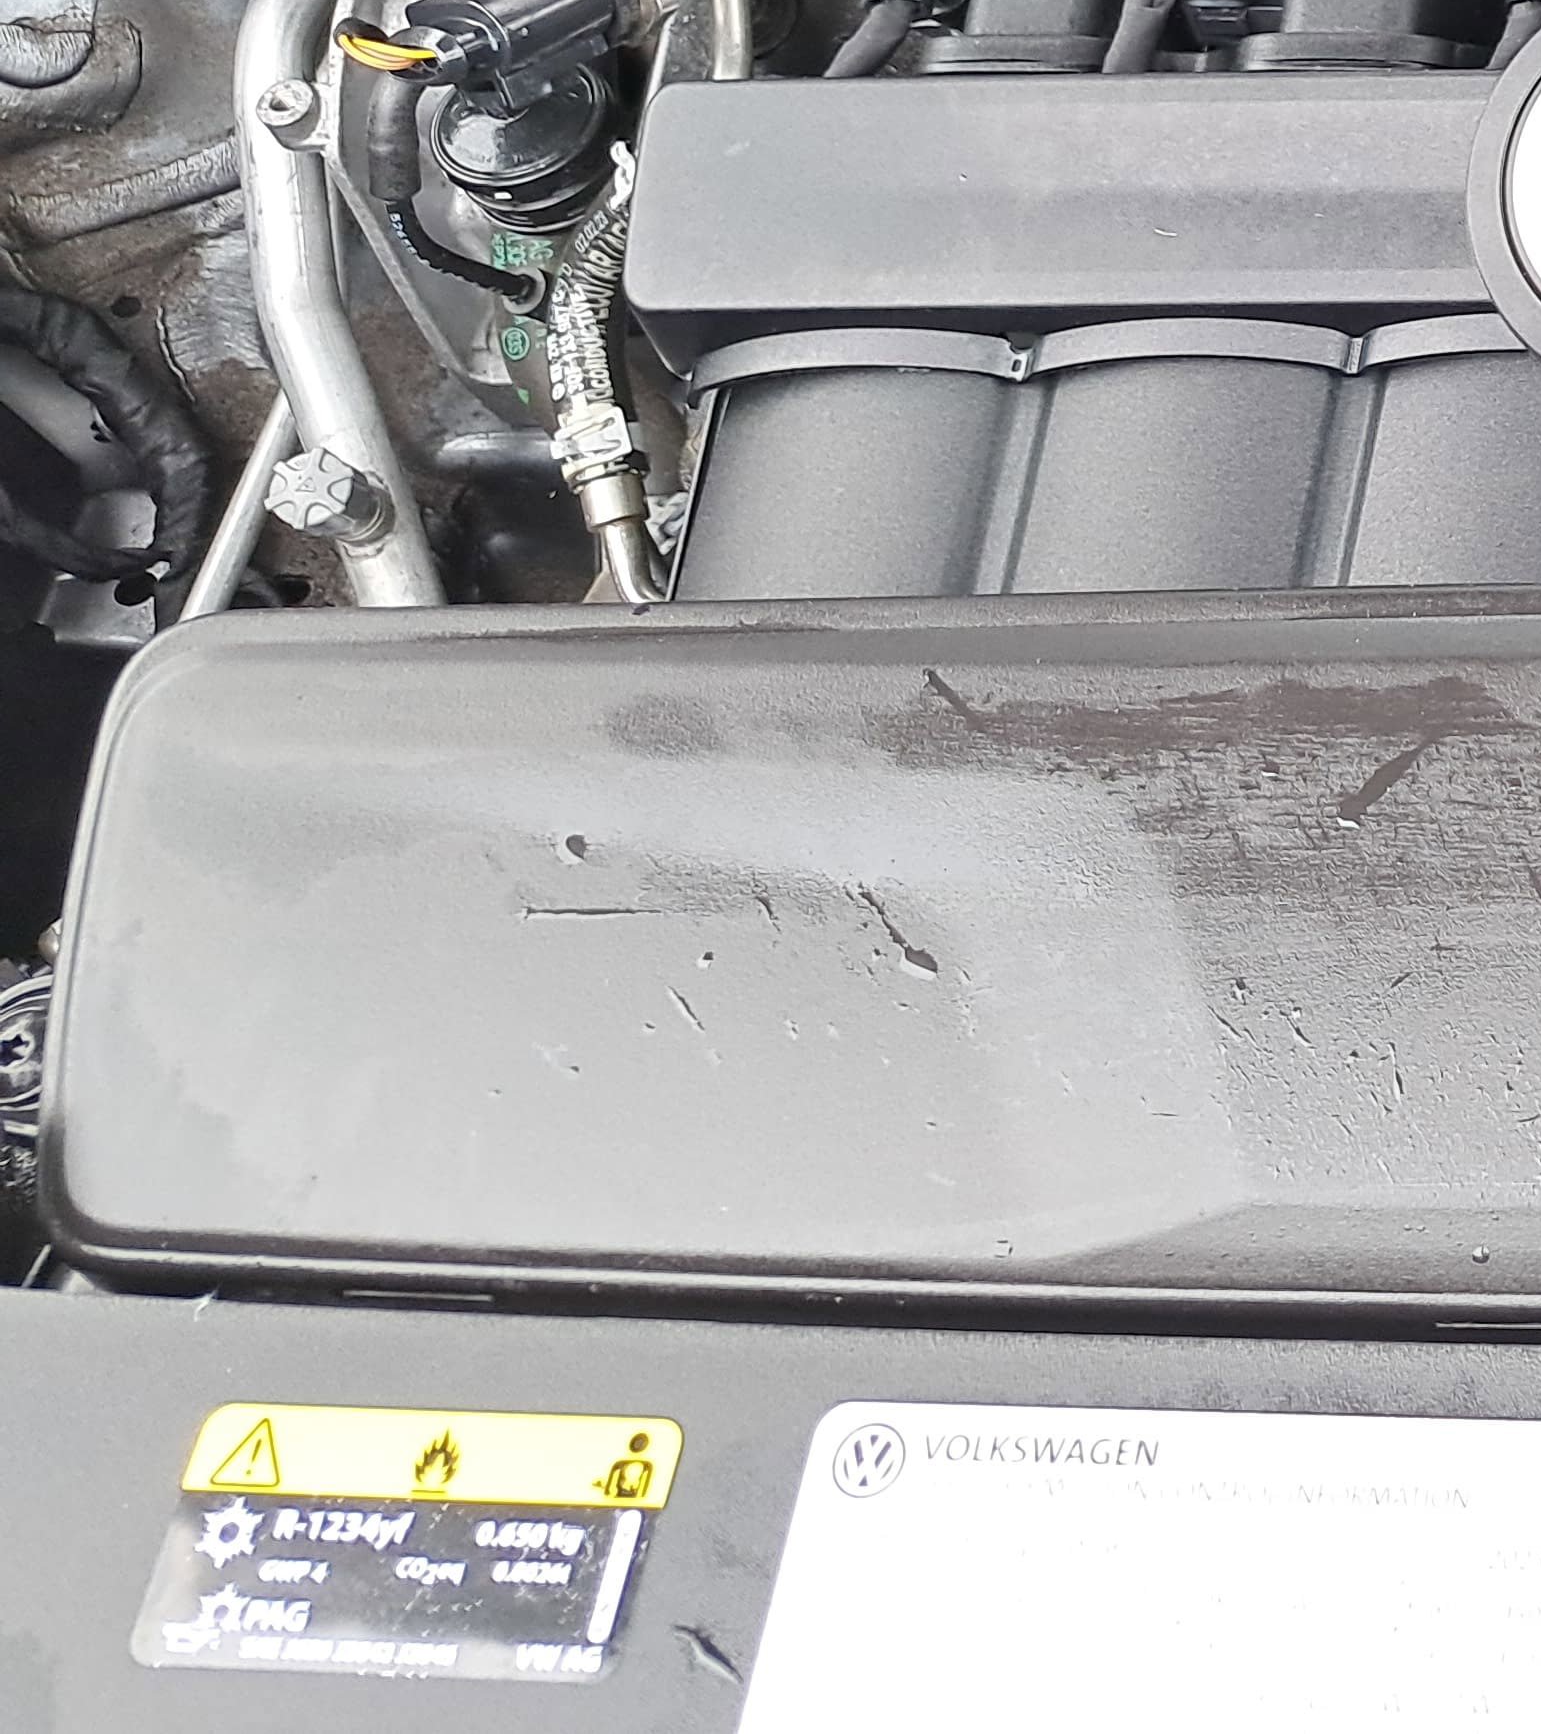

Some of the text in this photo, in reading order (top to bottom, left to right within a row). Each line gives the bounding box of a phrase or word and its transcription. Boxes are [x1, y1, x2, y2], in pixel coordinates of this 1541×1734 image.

[925, 1434, 1161, 1468] VOLKSWAGEN
[273, 1509, 414, 1550] R-1234yf
[244, 1598, 312, 1633] PAG
[515, 1643, 604, 1674] VW AG
